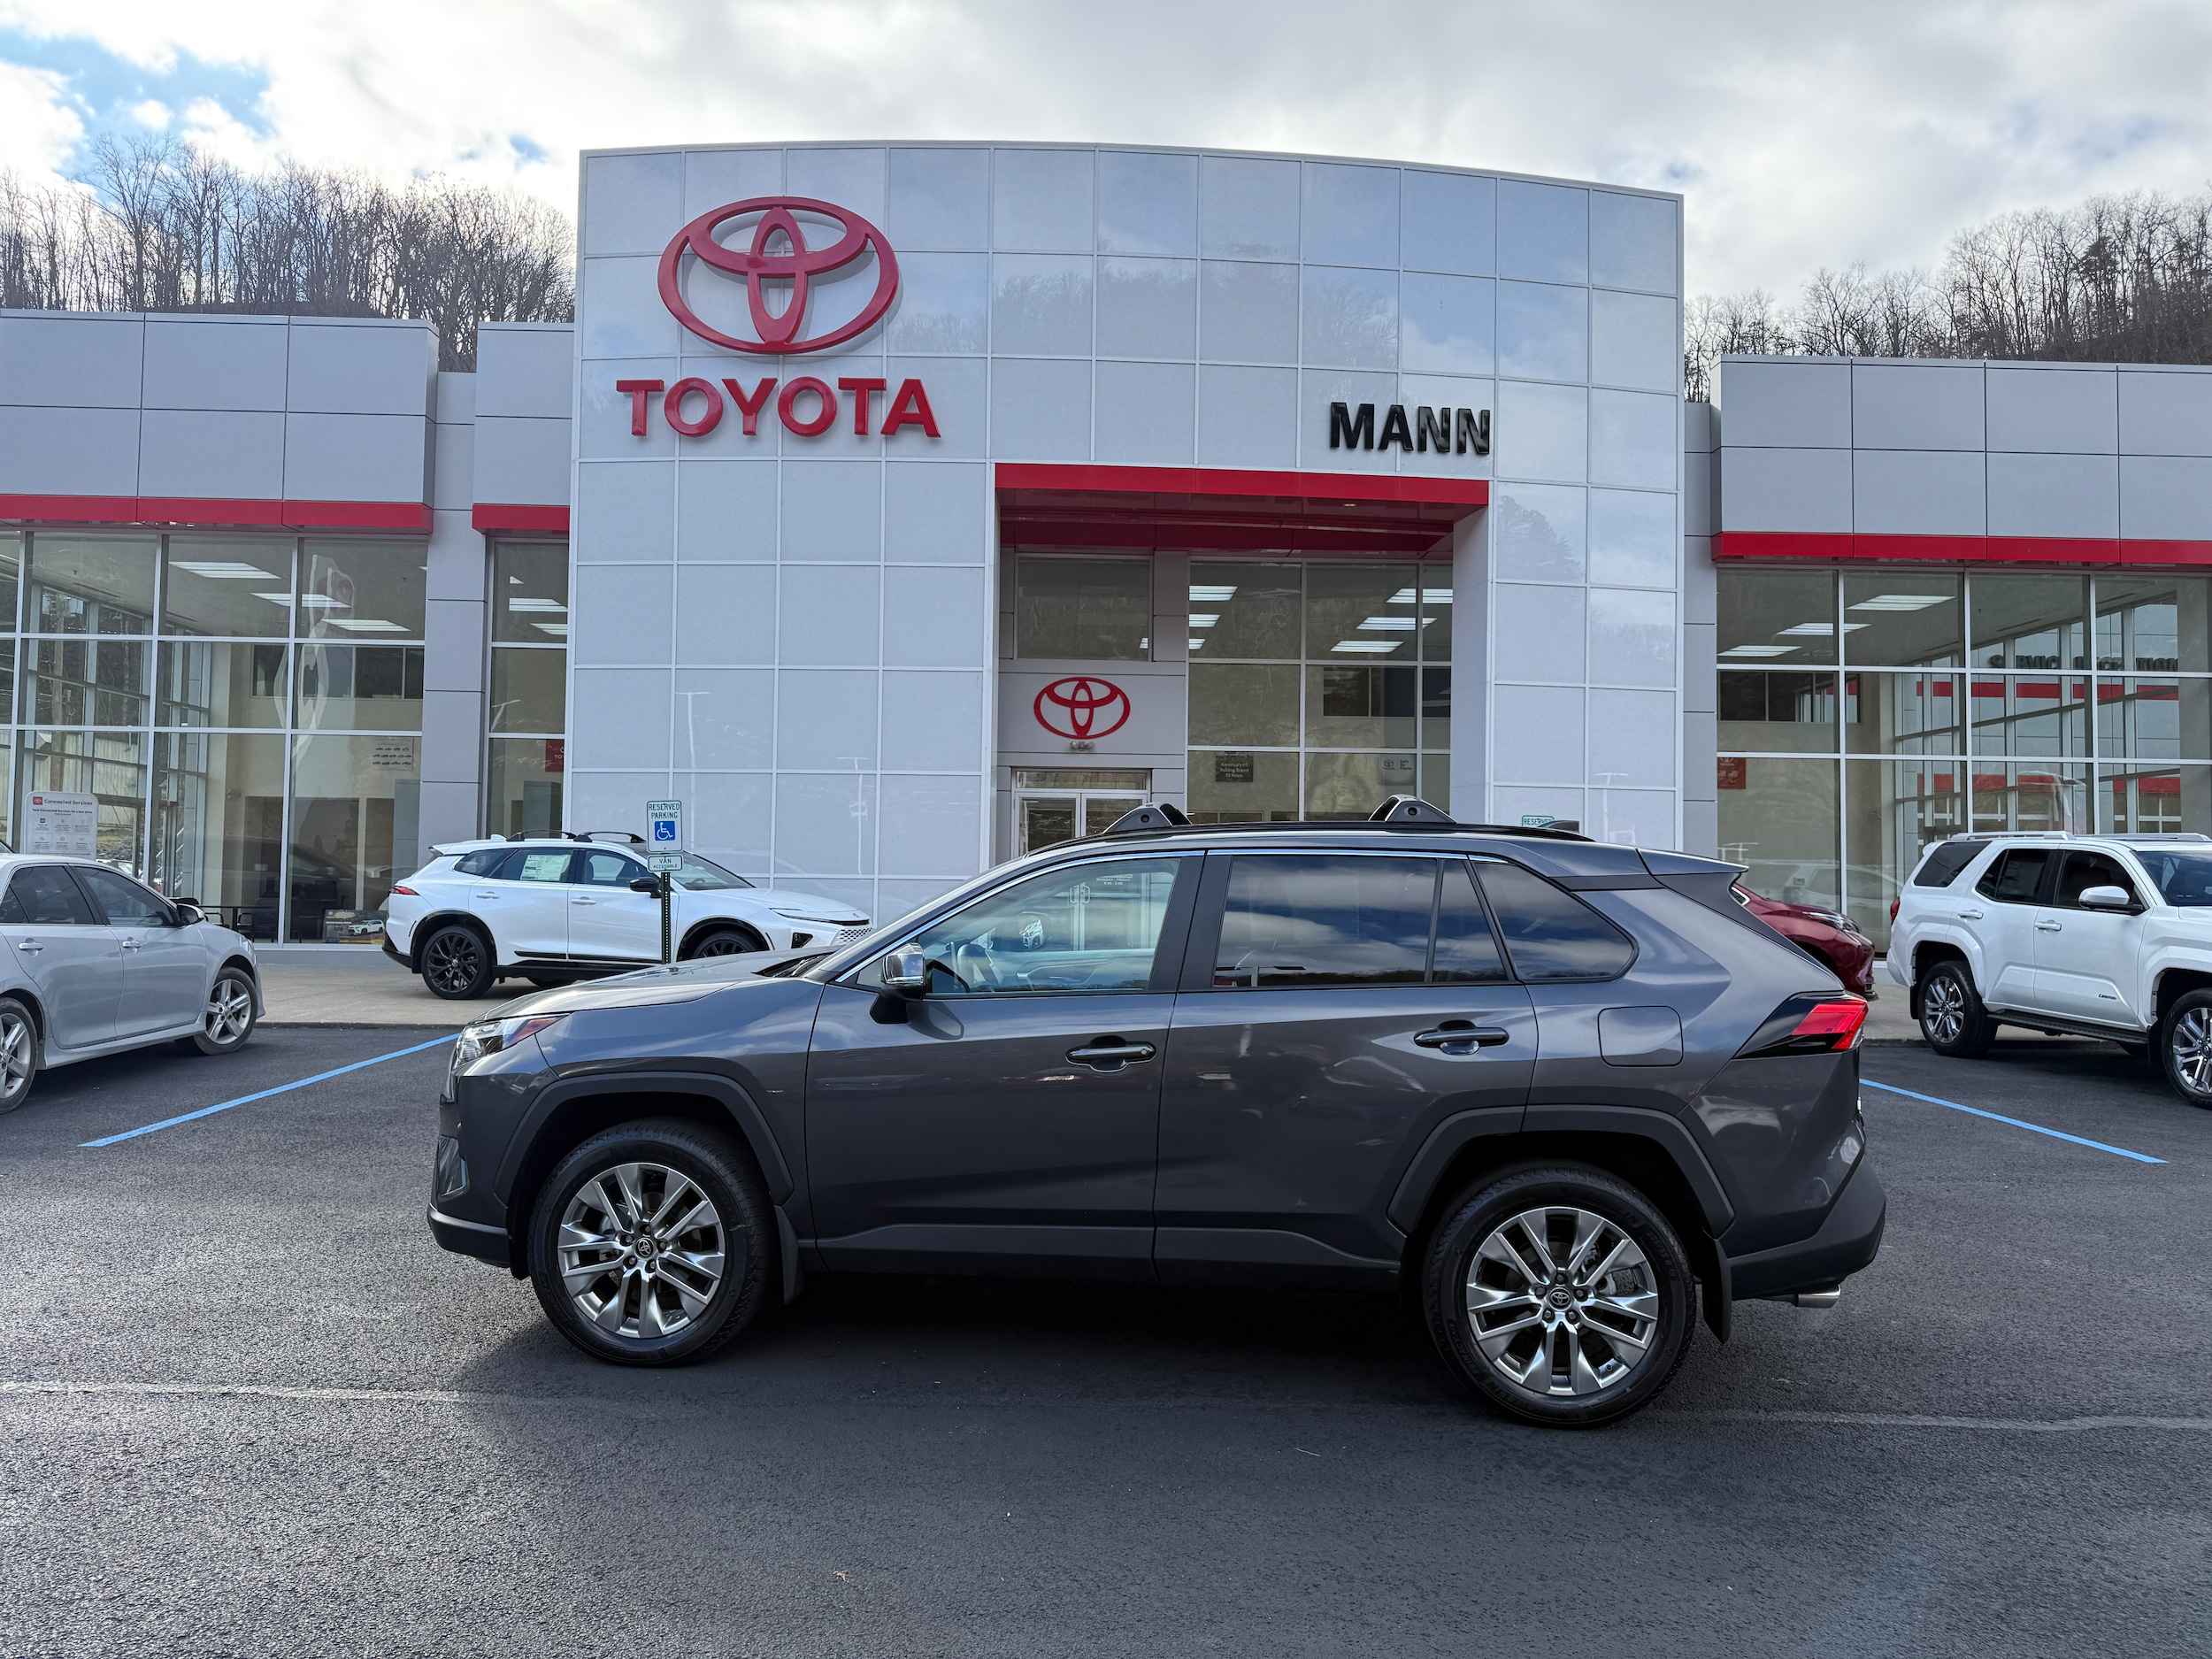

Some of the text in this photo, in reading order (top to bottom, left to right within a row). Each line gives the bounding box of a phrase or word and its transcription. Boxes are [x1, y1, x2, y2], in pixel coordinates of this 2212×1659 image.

[616, 376, 941, 437] TOYOTA
[1330, 403, 1490, 455] MANN
[1452, 1334, 1480, 1376] PRIMACY
